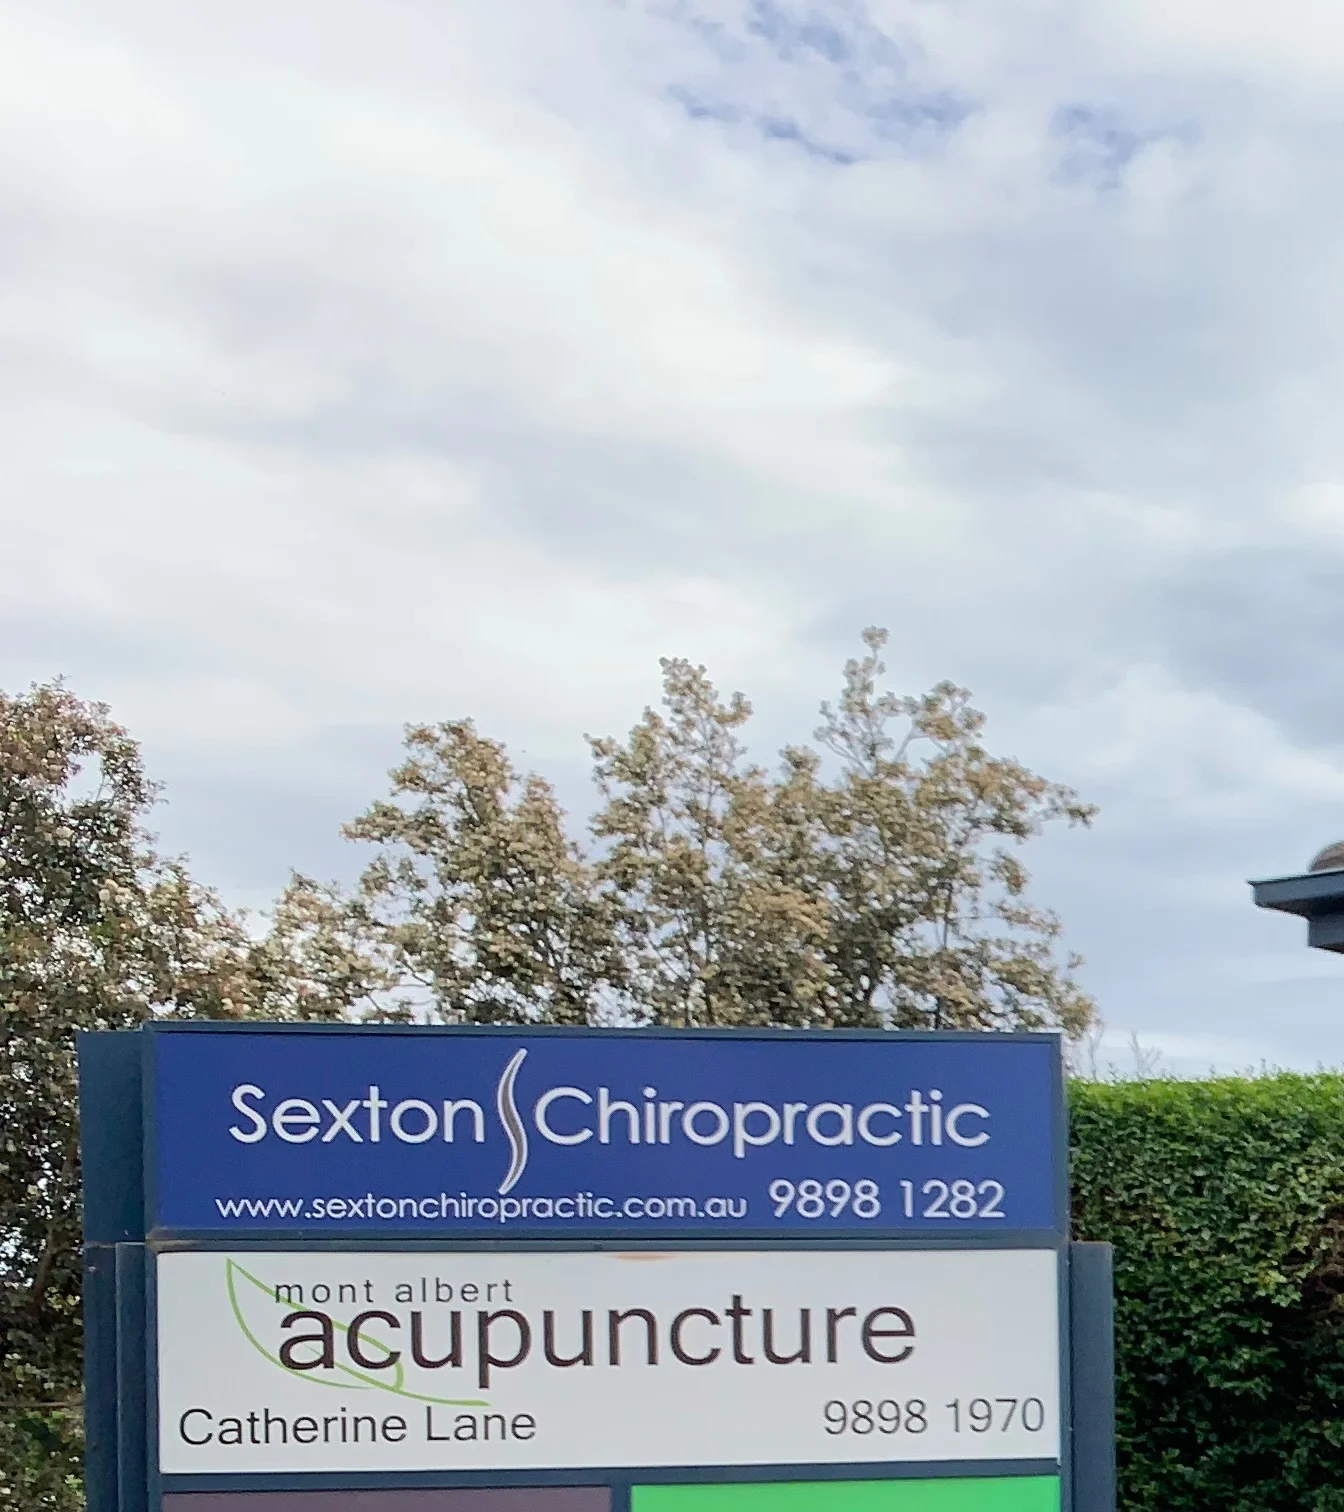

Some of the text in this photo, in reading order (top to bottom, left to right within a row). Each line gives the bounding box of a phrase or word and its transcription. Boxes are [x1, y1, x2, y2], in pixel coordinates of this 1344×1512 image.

[228, 1084, 992, 1158] Sexton Chiropractic
[215, 1191, 747, 1225] www.sextonchiropractic.com.au
[769, 1179, 1006, 1219] 9898 1282
[274, 1277, 514, 1304] mont albert
[278, 1294, 916, 1389] acupuncture
[179, 1406, 537, 1446] Catherine Lane
[823, 1397, 1045, 1435] 9898 1970
